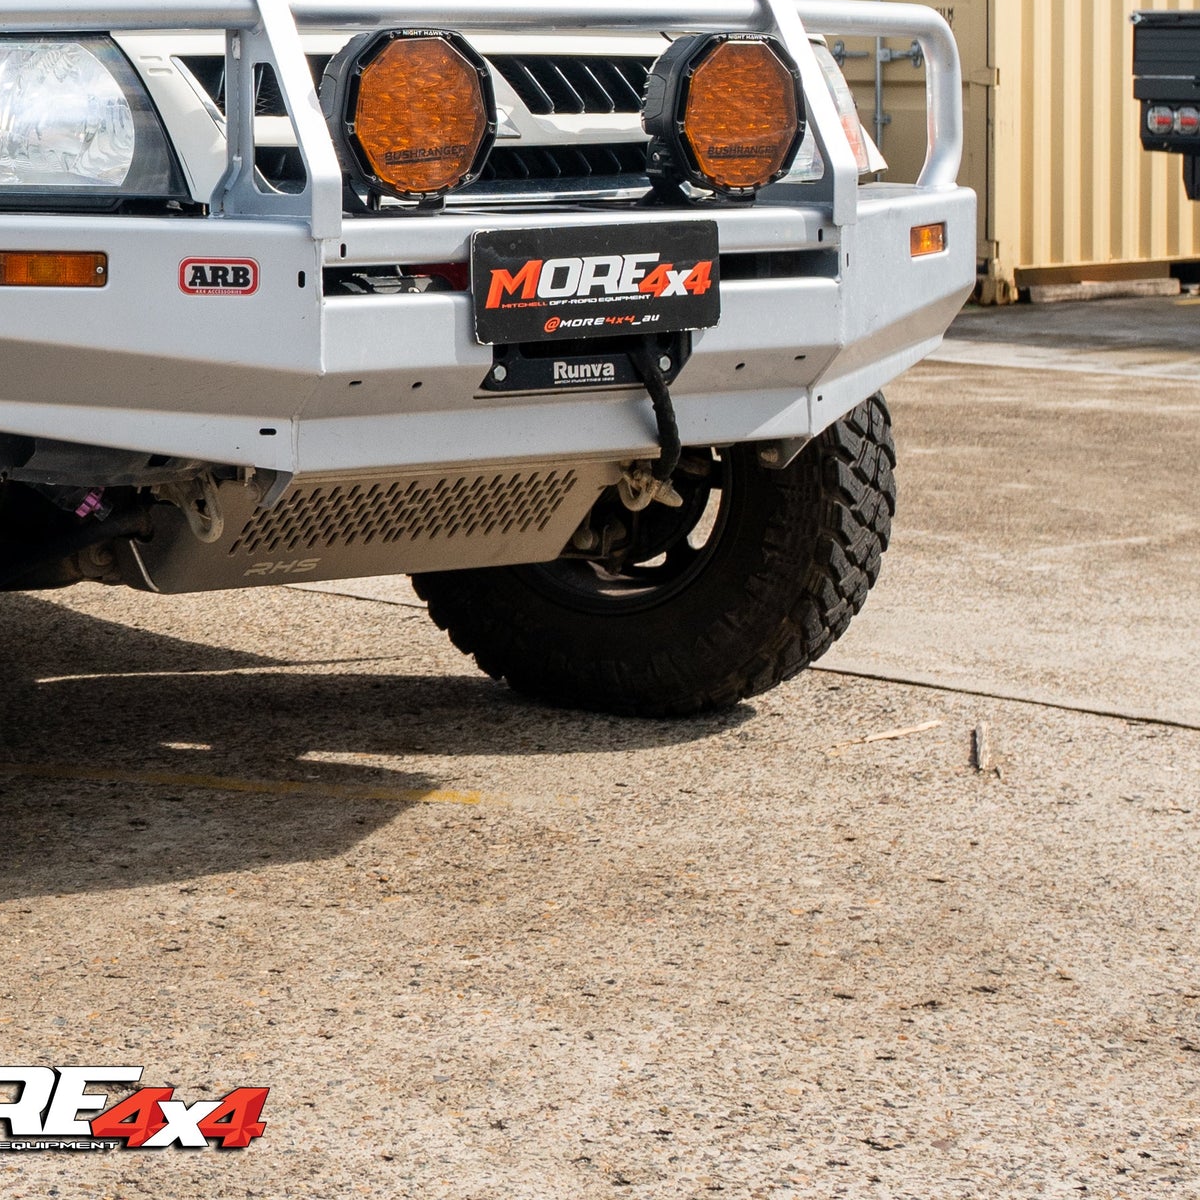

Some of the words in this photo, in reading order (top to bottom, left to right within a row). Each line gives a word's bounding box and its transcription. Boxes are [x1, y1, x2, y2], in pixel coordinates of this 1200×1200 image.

[384, 144, 467, 161] BUSHRANGER
[708, 144, 777, 155] BUSHRANGER
[188, 265, 251, 288] ARB
[549, 297, 598, 306] OFF-ROAD
[599, 294, 651, 303] EQUIPMENT
[543, 313, 660, 333] @MORE4x4_au
[553, 361, 615, 380] Runva
[242, 557, 322, 577] RHS
